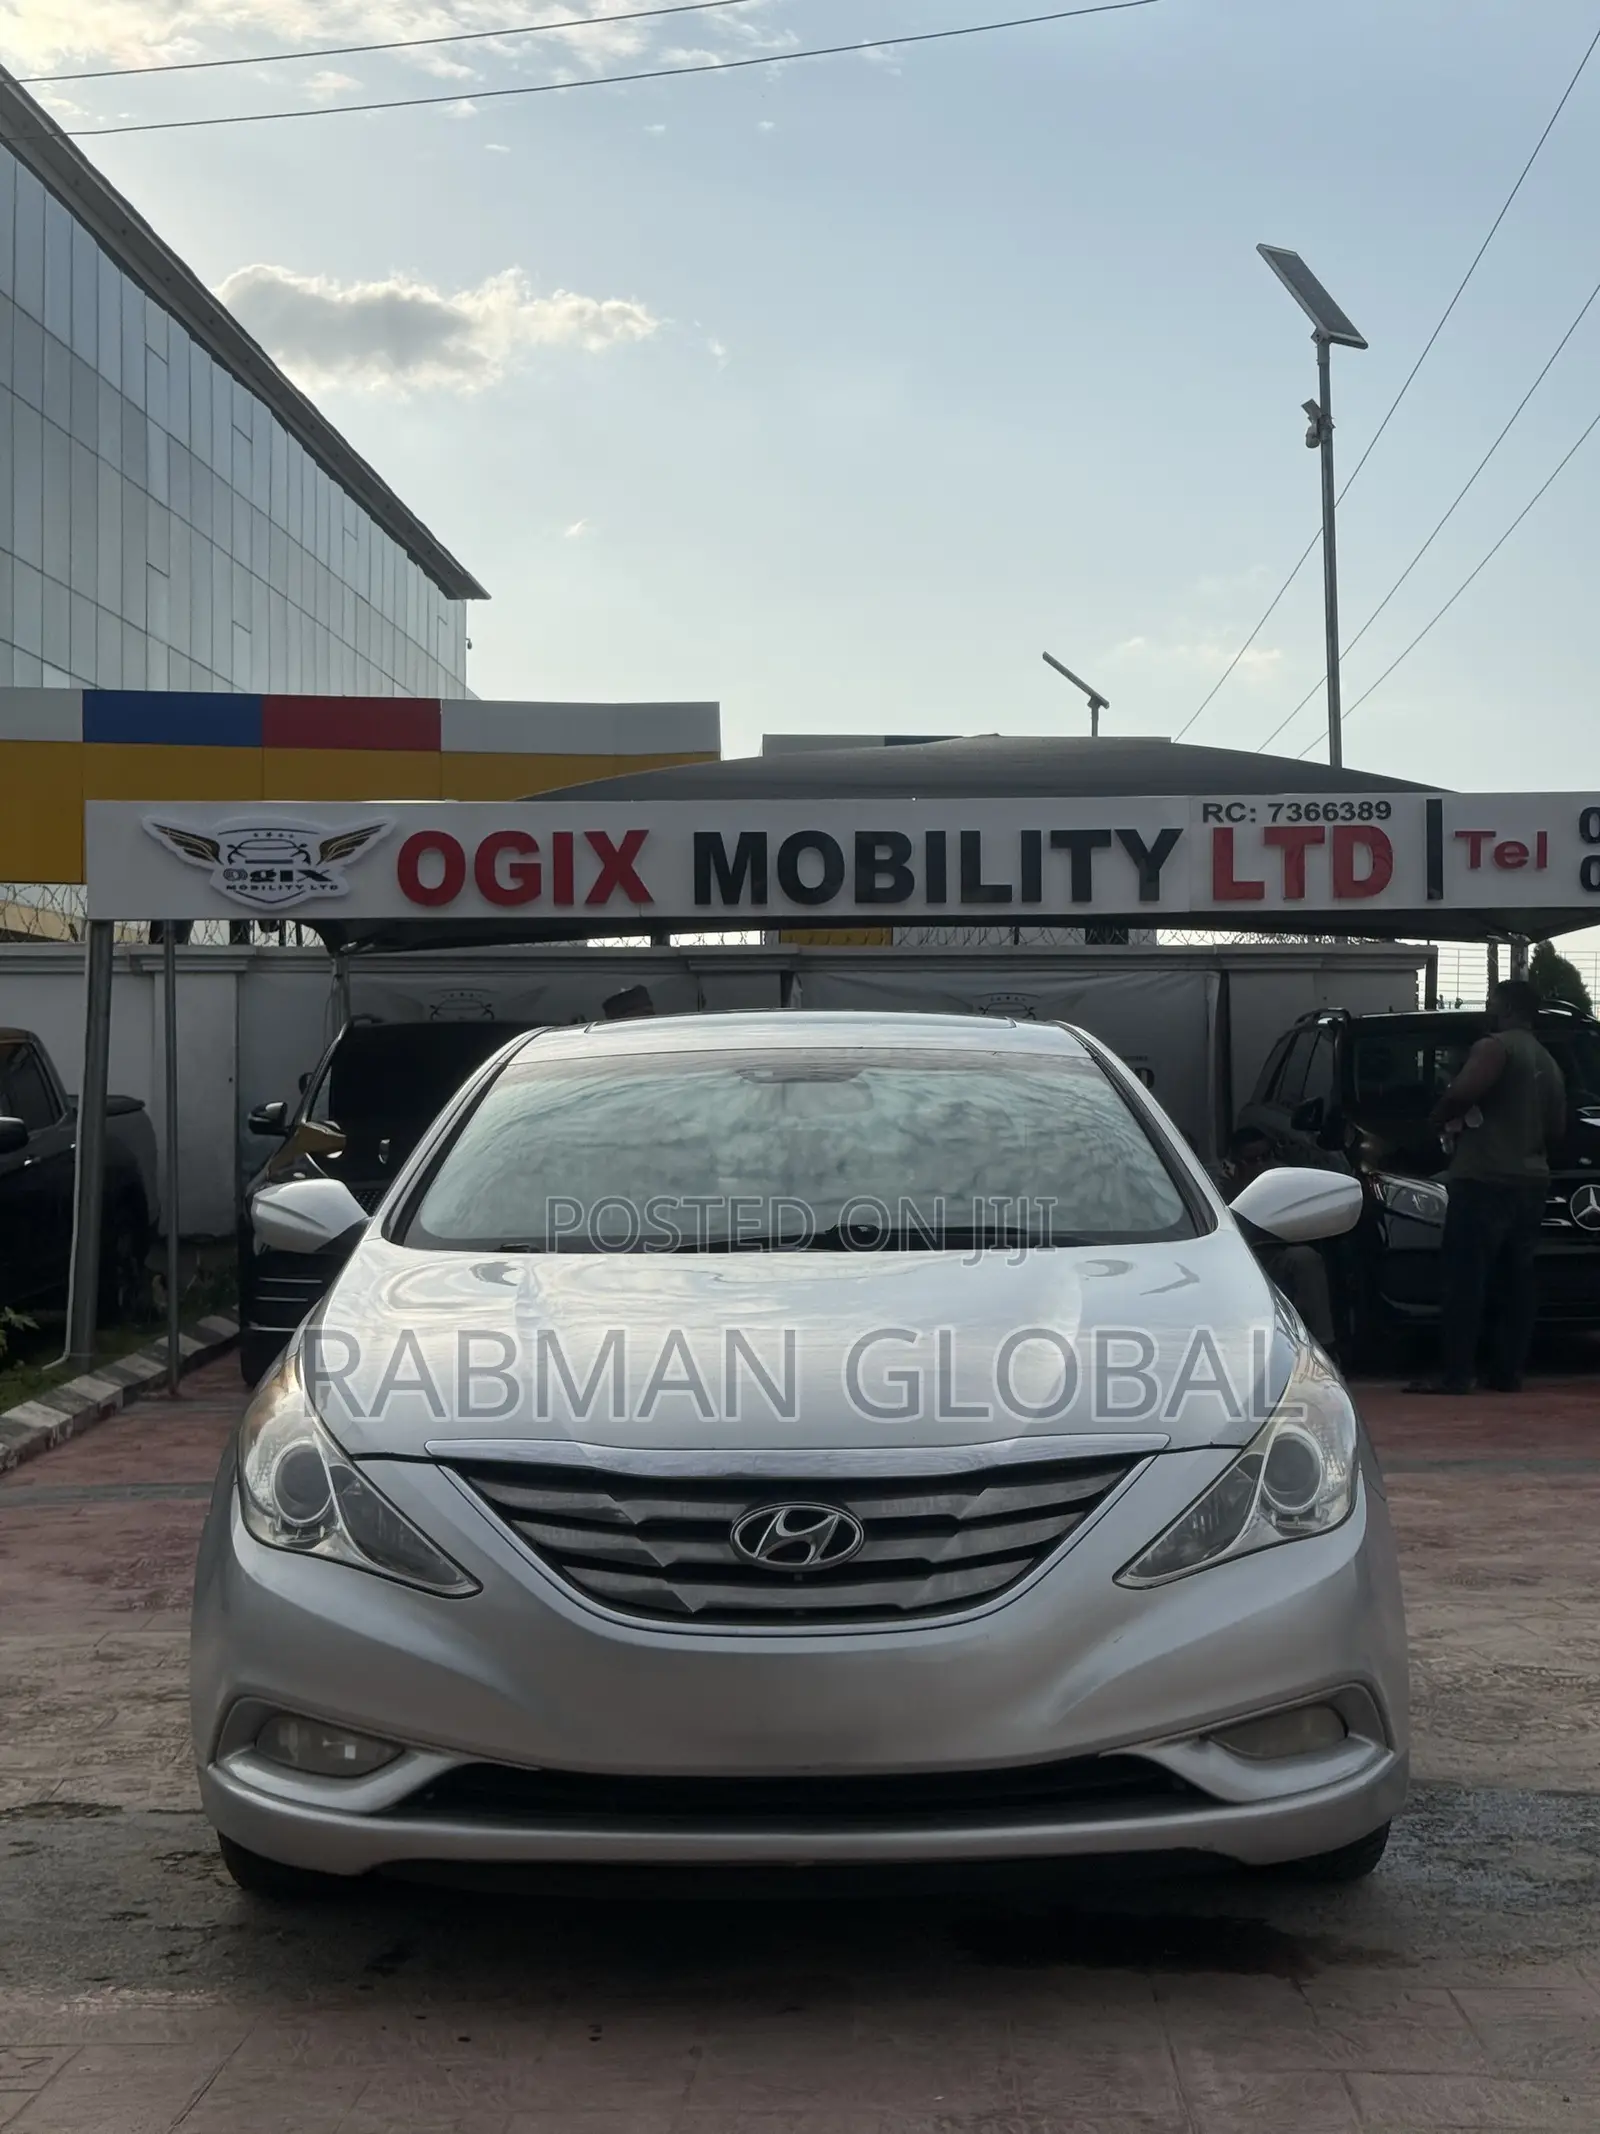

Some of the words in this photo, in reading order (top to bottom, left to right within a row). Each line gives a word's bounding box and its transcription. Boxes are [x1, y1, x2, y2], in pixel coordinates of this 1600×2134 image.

[1201, 801, 1257, 823] RC:
[1267, 800, 1392, 823] 7366389
[397, 829, 654, 907] OGIX
[693, 828, 1184, 905] MOBILITY
[1212, 825, 1394, 901] LTD
[1454, 830, 1548, 870] Tel
